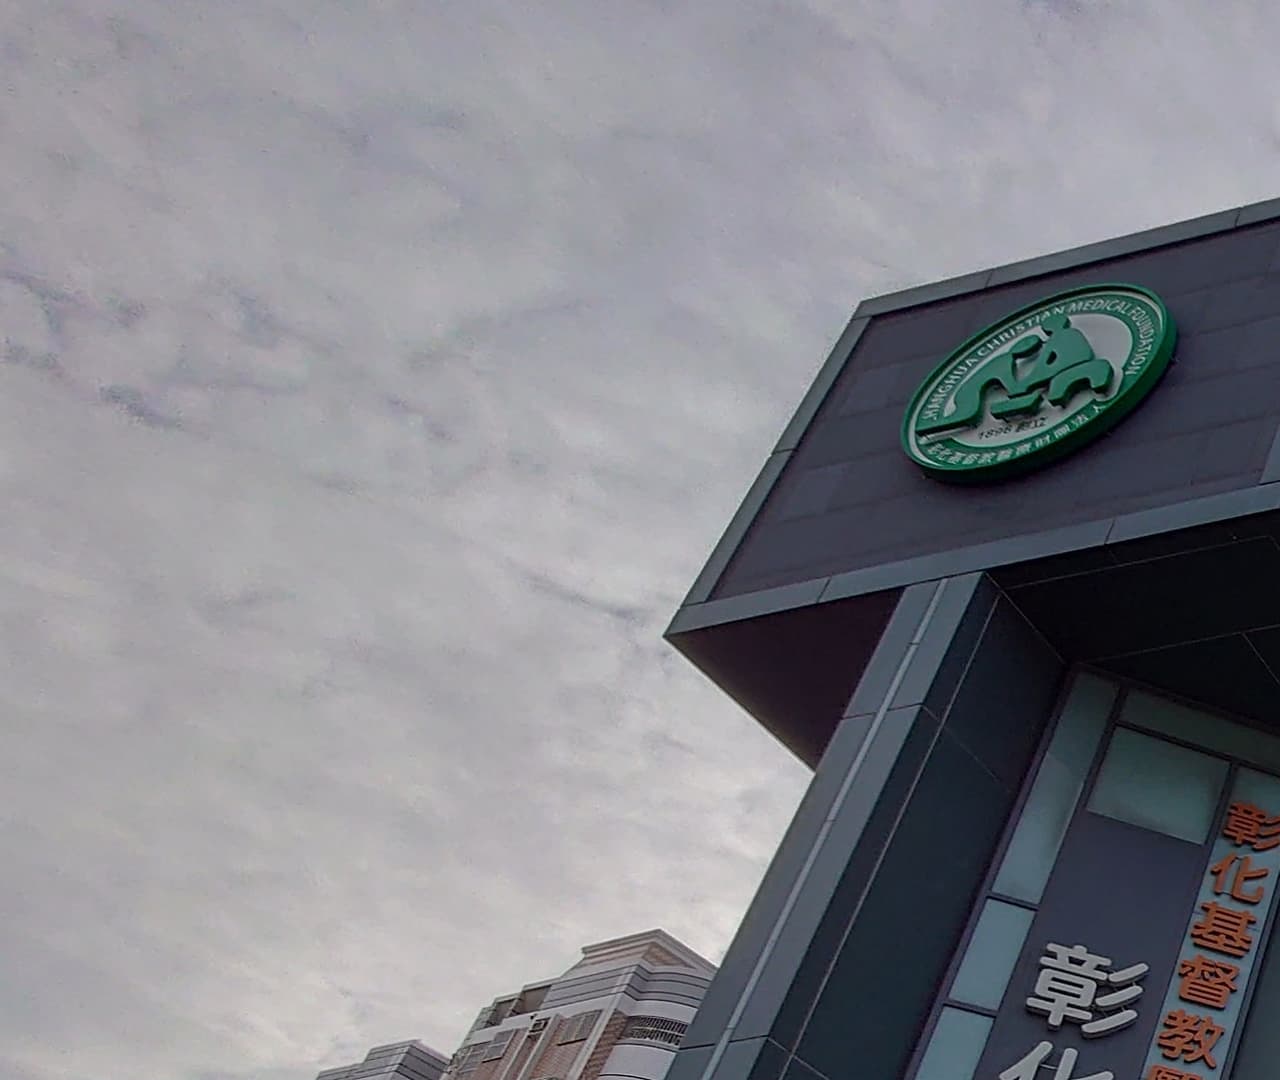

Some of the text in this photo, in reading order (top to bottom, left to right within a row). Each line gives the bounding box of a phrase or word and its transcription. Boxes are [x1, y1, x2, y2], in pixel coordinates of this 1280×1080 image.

[921, 299, 1155, 421] HANGHUA CHRISTIAN MEDICAL FOUNDATION
